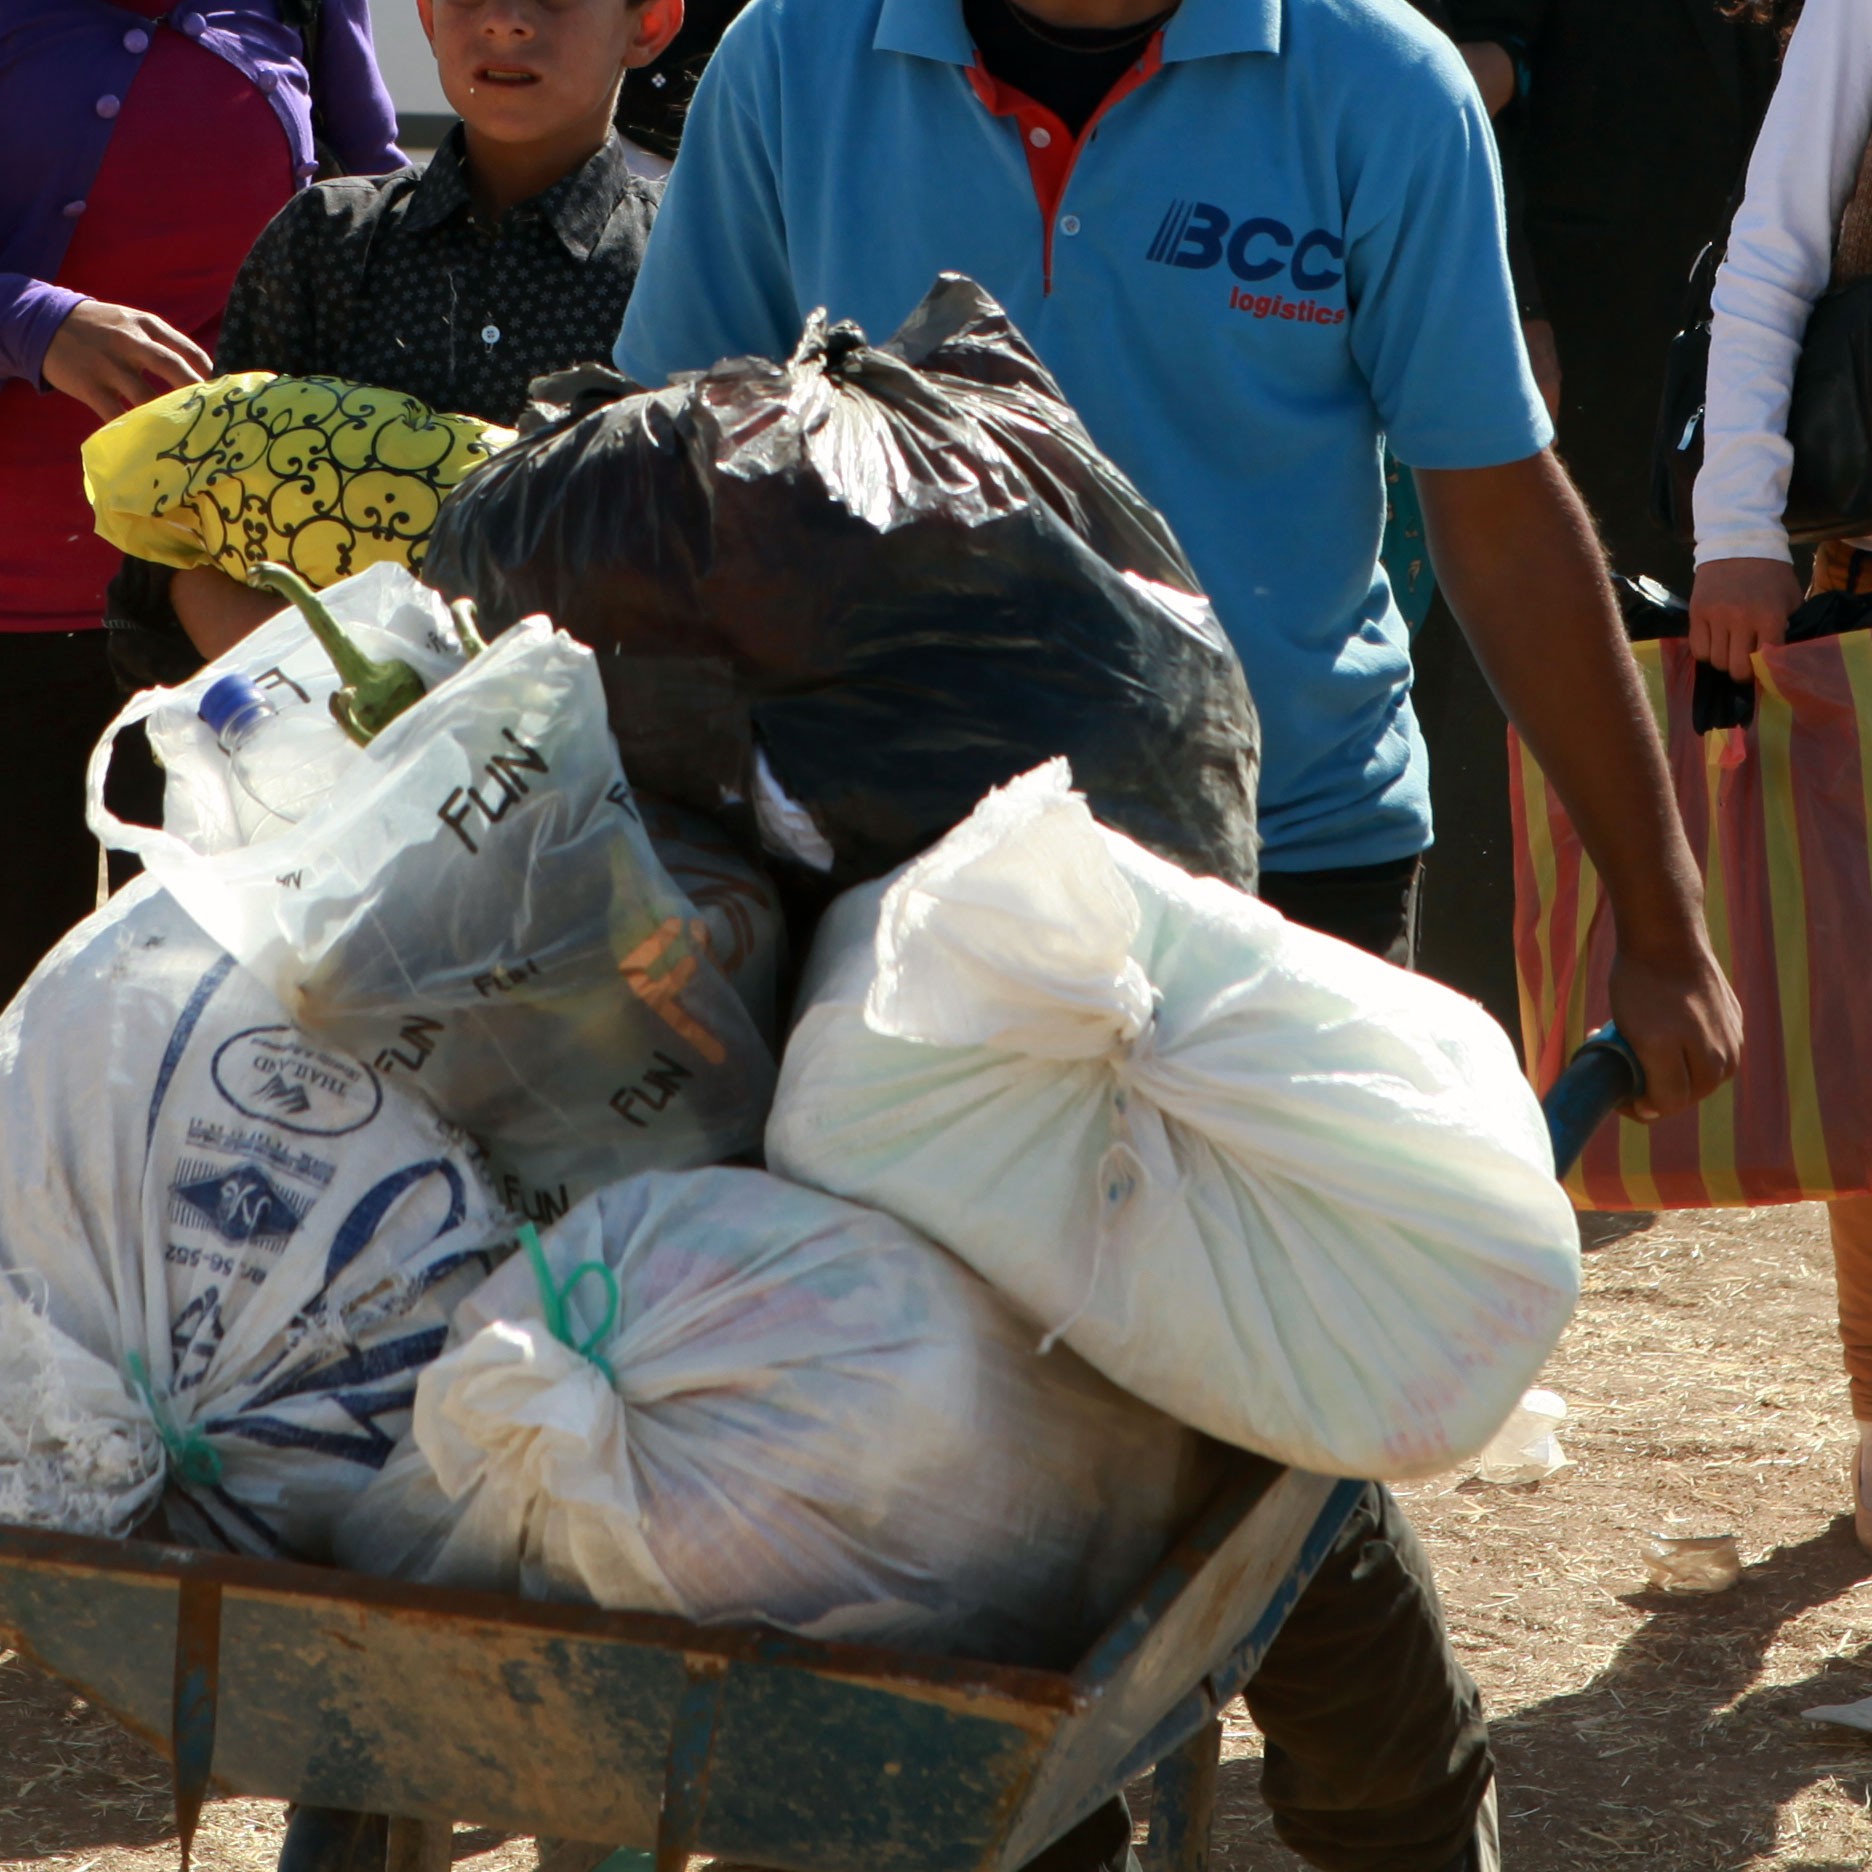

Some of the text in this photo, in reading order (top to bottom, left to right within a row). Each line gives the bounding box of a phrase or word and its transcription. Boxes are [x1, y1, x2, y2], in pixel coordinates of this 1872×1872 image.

[1145, 198, 1345, 292] BCC
[1229, 285, 1346, 325] logistics
[437, 727, 549, 855] FUN
[374, 1014, 446, 1073] FUN
[609, 1050, 694, 1128] FUN
[501, 1173, 569, 1225] FUN
